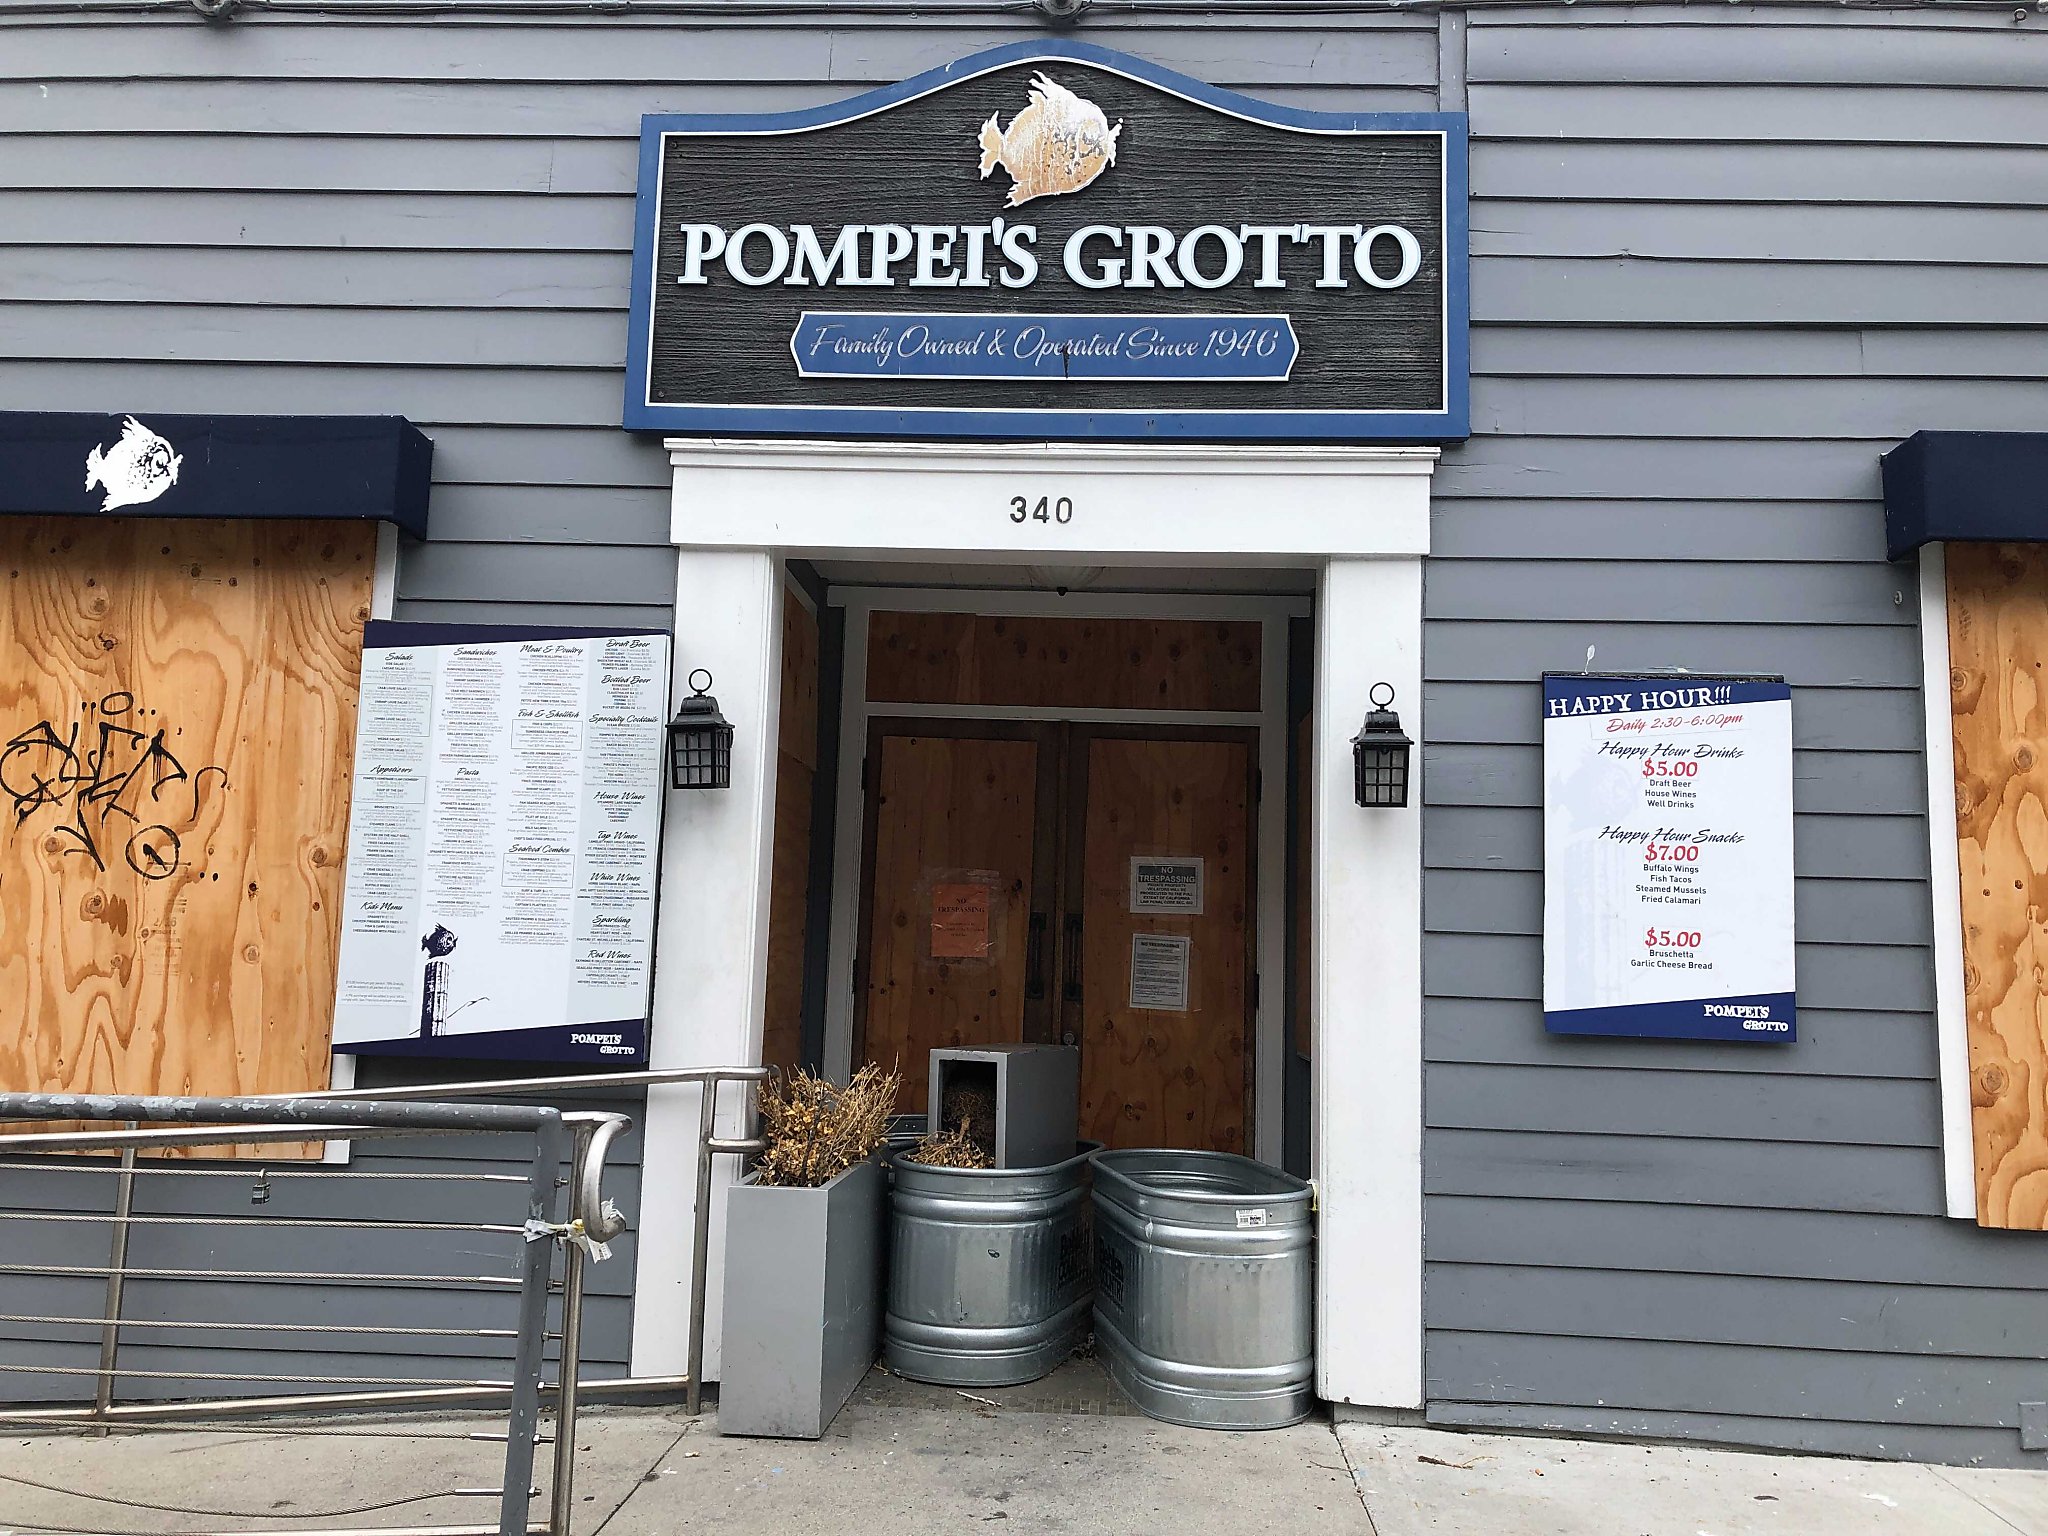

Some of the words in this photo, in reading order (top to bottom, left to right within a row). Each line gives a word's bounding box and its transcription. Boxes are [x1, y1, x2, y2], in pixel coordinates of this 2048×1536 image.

[677, 216, 1039, 290] POMPEI'S
[1063, 223, 1422, 290] GROTTO
[809, 322, 893, 370] Family
[895, 325, 982, 360] Owned
[986, 326, 1008, 358] &
[1013, 325, 1123, 368] Operated
[1126, 327, 1200, 360] Since
[1204, 327, 1278, 359] 1946
[1009, 495, 1074, 525] 340
[520, 644, 542, 653] Meat
[543, 645, 554, 653] &
[630, 640, 650, 648] Beer
[384, 652, 414, 661] Salads
[453, 647, 498, 656] Sandwiches
[630, 676, 652, 684] Beer
[1548, 693, 1632, 717] HAPPY
[1640, 686, 1731, 710] HOUR!!!
[518, 708, 533, 718] Fish
[534, 710, 546, 718] &
[546, 709, 580, 718] Shellfish
[1606, 718, 1646, 733] Daily
[1650, 713, 1744, 729] 2:30-6:00pm
[1597, 741, 1650, 760] Happy
[1650, 743, 1690, 757] Hour
[1694, 744, 1745, 759] Drinks
[456, 767, 480, 776] Pasta
[1642, 758, 1698, 779] $5.00
[1672, 780, 1692, 788] Beer
[593, 791, 619, 800] House
[621, 792, 646, 800] Wines
[1645, 790, 1670, 798] House
[1672, 790, 1697, 798] Wines
[1647, 800, 1666, 808] Well
[1667, 800, 1694, 809] Drinks
[598, 830, 611, 841] Tap
[613, 831, 638, 840] Wines
[1598, 825, 1650, 844] Happy
[1651, 827, 1692, 842] Hour
[1690, 828, 1746, 845] Snacks
[1645, 842, 1699, 863] $7.00
[1643, 864, 1672, 872] Buffalo
[1674, 865, 1699, 874] Wings
[590, 872, 614, 881] White
[616, 873, 640, 881] Wines
[1669, 875, 1692, 884] Tacos
[1635, 885, 1671, 893] Steamed
[1673, 886, 1707, 895] Mussels
[1664, 896, 1701, 905] Calamari
[360, 902, 378, 910] Kids
[379, 902, 403, 911] Menu
[592, 914, 631, 926] Sparkling
[1645, 927, 1702, 949] $5.00
[588, 950, 606, 958] Red
[606, 950, 632, 958] Wines
[1649, 950, 1694, 959] Bruschetta
[1630, 960, 1655, 968] Garlic
[1657, 960, 1686, 969] Cheese
[1688, 962, 1713, 970] Bread
[1703, 1004, 1770, 1019] POMPEI'S
[1742, 1020, 1789, 1032] GROTTO
[570, 1034, 622, 1045] POMPEI'S
[600, 1046, 635, 1055] GROTTO
